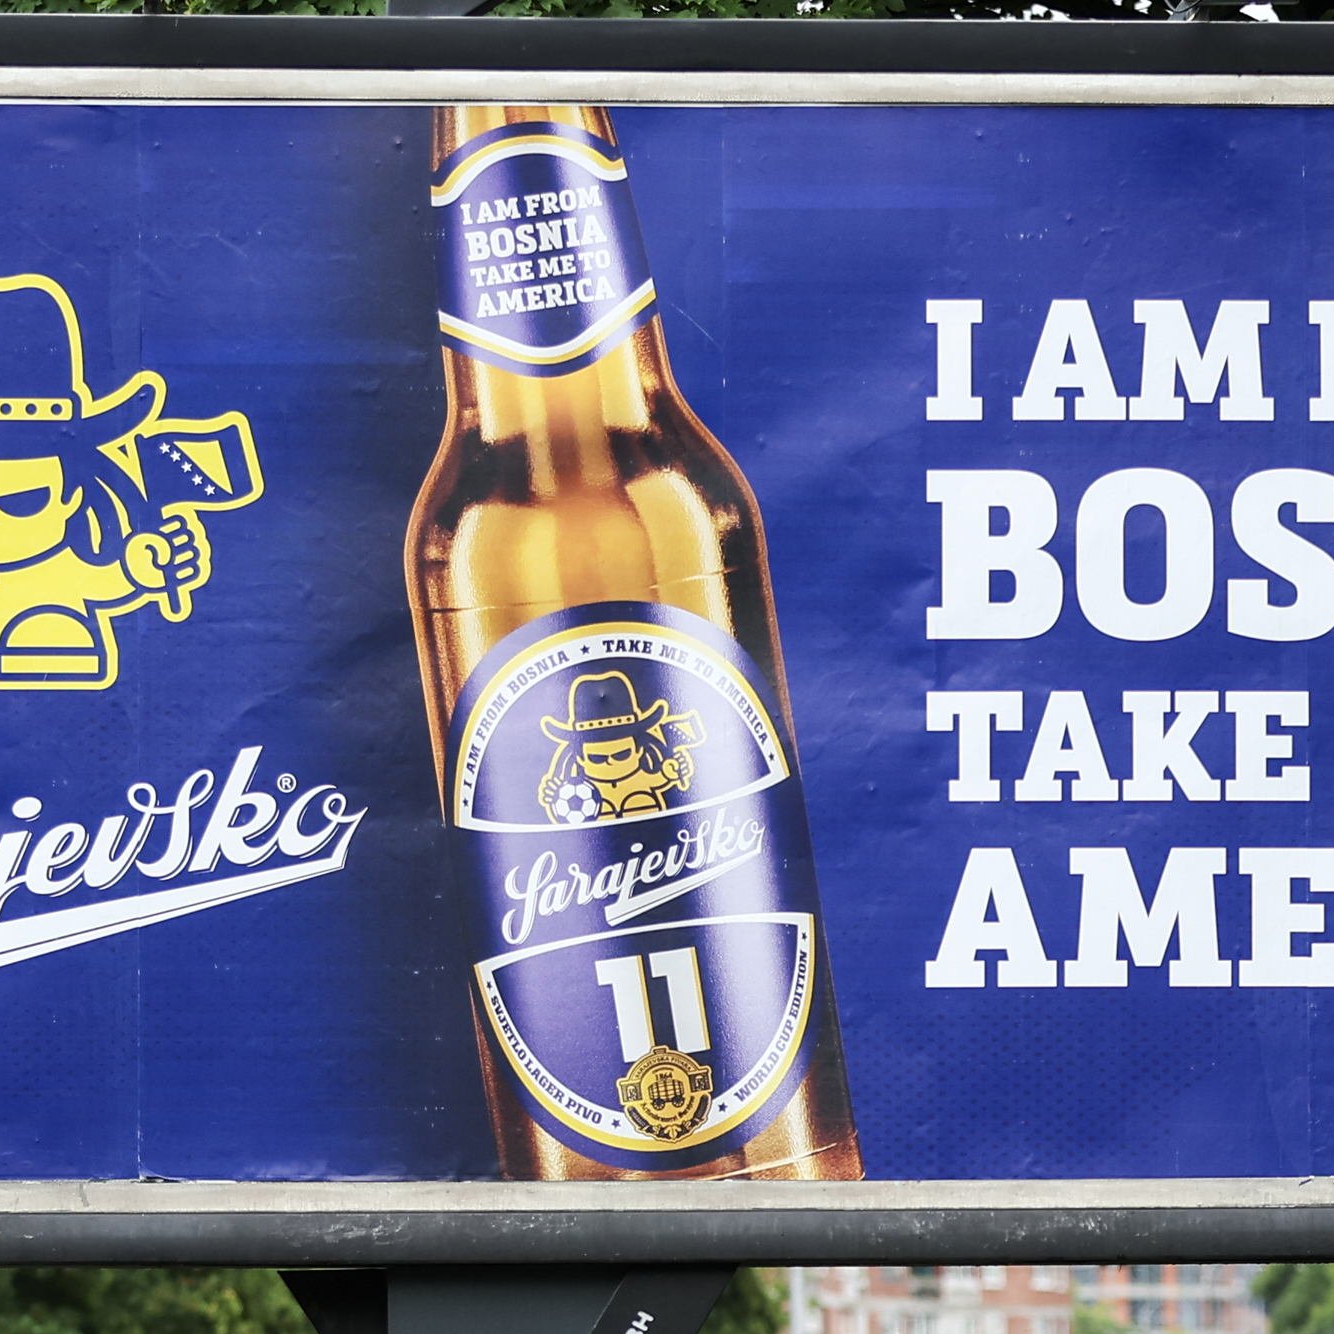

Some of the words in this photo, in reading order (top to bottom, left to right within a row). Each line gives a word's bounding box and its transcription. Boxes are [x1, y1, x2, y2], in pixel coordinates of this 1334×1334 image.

[460, 203, 473, 226] I
[476, 197, 521, 224] AM
[523, 185, 603, 218] FROM
[464, 214, 608, 262] BOSNIA
[470, 260, 535, 287] TAKE
[537, 254, 577, 279] ME
[578, 249, 611, 272] TO
[476, 276, 617, 318] AMERICA
[925, 299, 984, 422] I
[1011, 299, 1275, 422] AM
[602, 639, 653, 655] TAKE
[658, 643, 688, 665] ME
[694, 657, 715, 679] TO
[506, 649, 571, 696] BOSNIA
[475, 692, 509, 742] FROM
[715, 675, 770, 746] AMERICA
[466, 743, 482, 776] AM
[925, 689, 1311, 803] TAKE
[463, 779, 473, 790] I
[501, 806, 766, 945] Sarajevsko
[594, 945, 712, 1064] 11
[733, 1054, 781, 1103] WORLD
[778, 1019, 794, 1054] CUP
[788, 949, 808, 1021] EDITION
[490, 994, 528, 1062] SVJETLO
[523, 1058, 567, 1107] LAGER
[564, 1097, 603, 1125] PIVO
